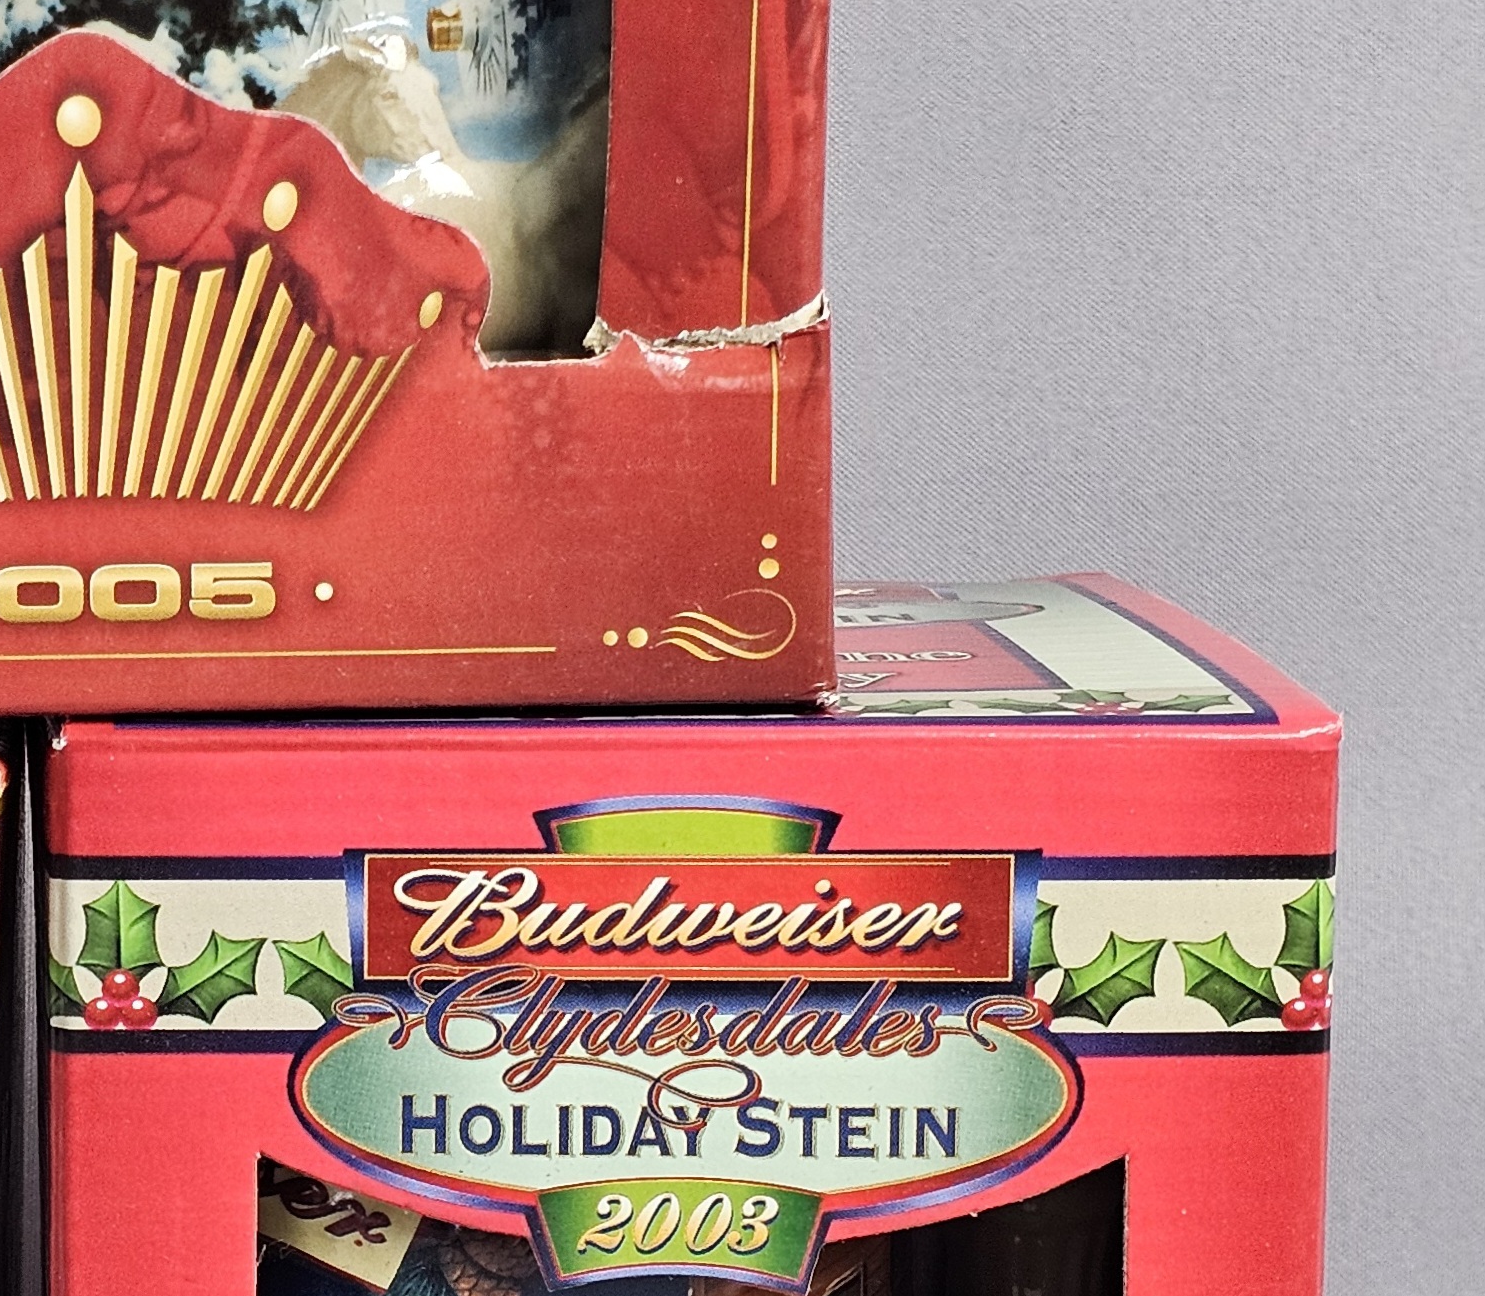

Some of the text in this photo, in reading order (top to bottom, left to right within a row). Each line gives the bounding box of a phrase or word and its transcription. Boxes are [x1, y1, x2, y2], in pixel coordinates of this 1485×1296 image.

[394, 866, 962, 960] Budweiser
[333, 965, 1044, 1103] Clydesdales
[399, 1094, 961, 1160] HOLIDAY STEIN
[576, 1193, 780, 1257] 2003
